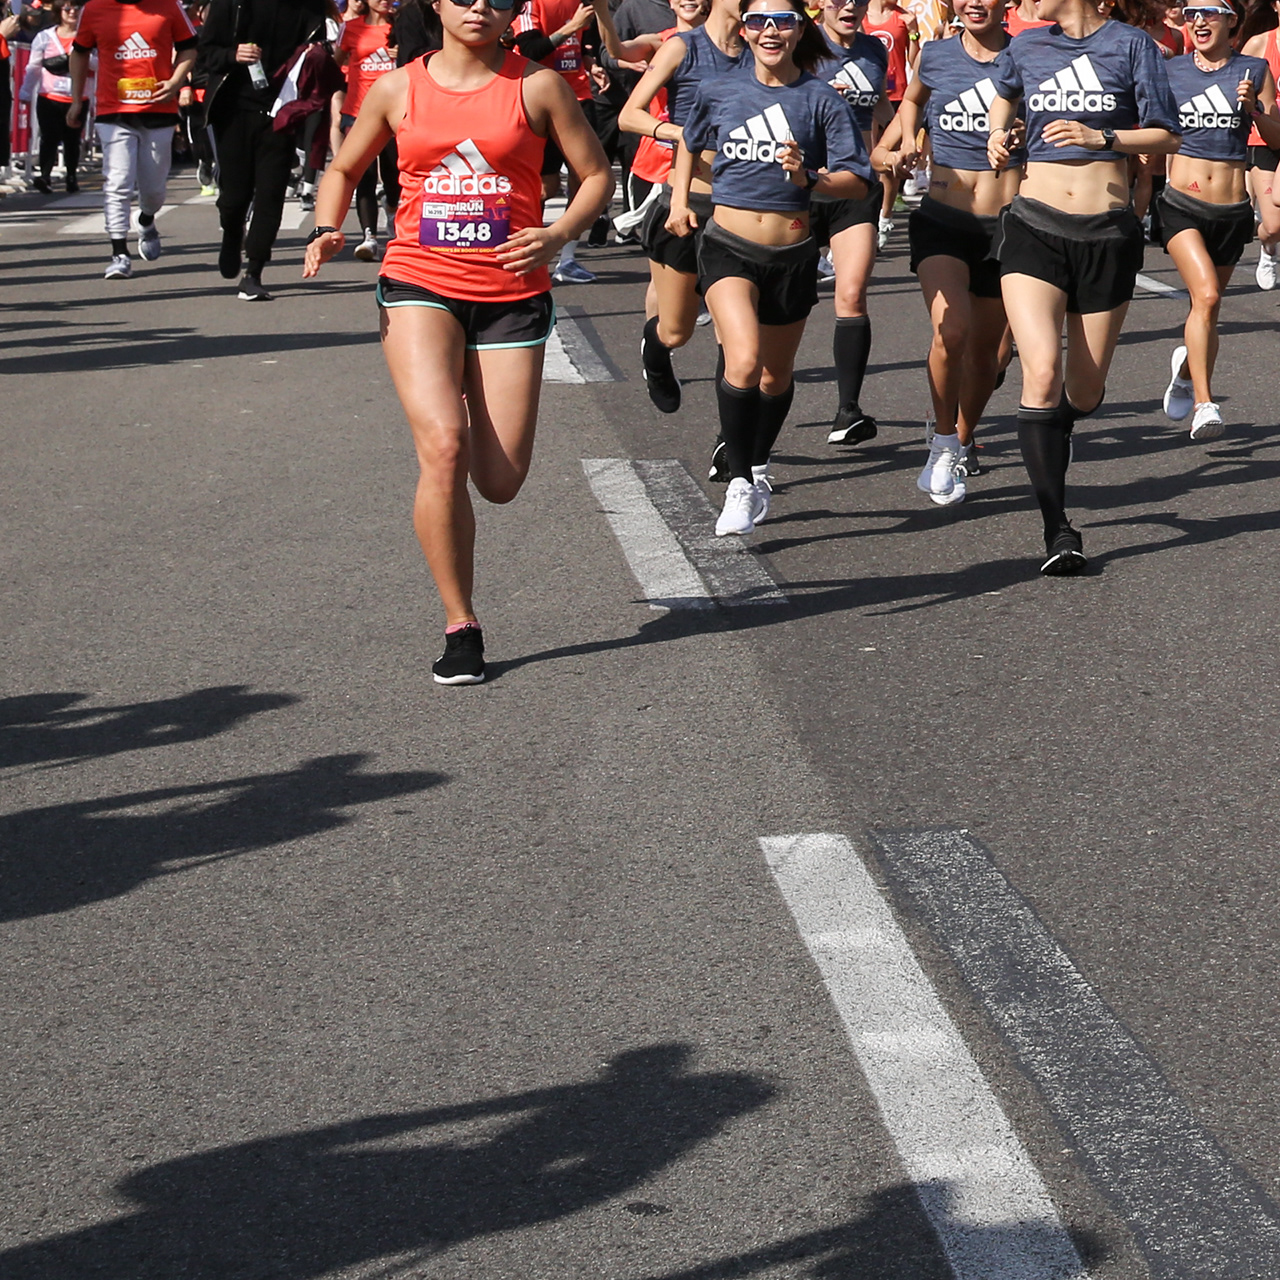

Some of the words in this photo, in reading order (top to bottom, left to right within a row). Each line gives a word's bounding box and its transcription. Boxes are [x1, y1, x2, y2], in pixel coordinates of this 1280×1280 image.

[114, 48, 157, 60] adidas
[1028, 88, 1117, 113] adidas
[938, 109, 990, 132] adid
[424, 174, 512, 195] adidas
[436, 221, 492, 241] 1348
